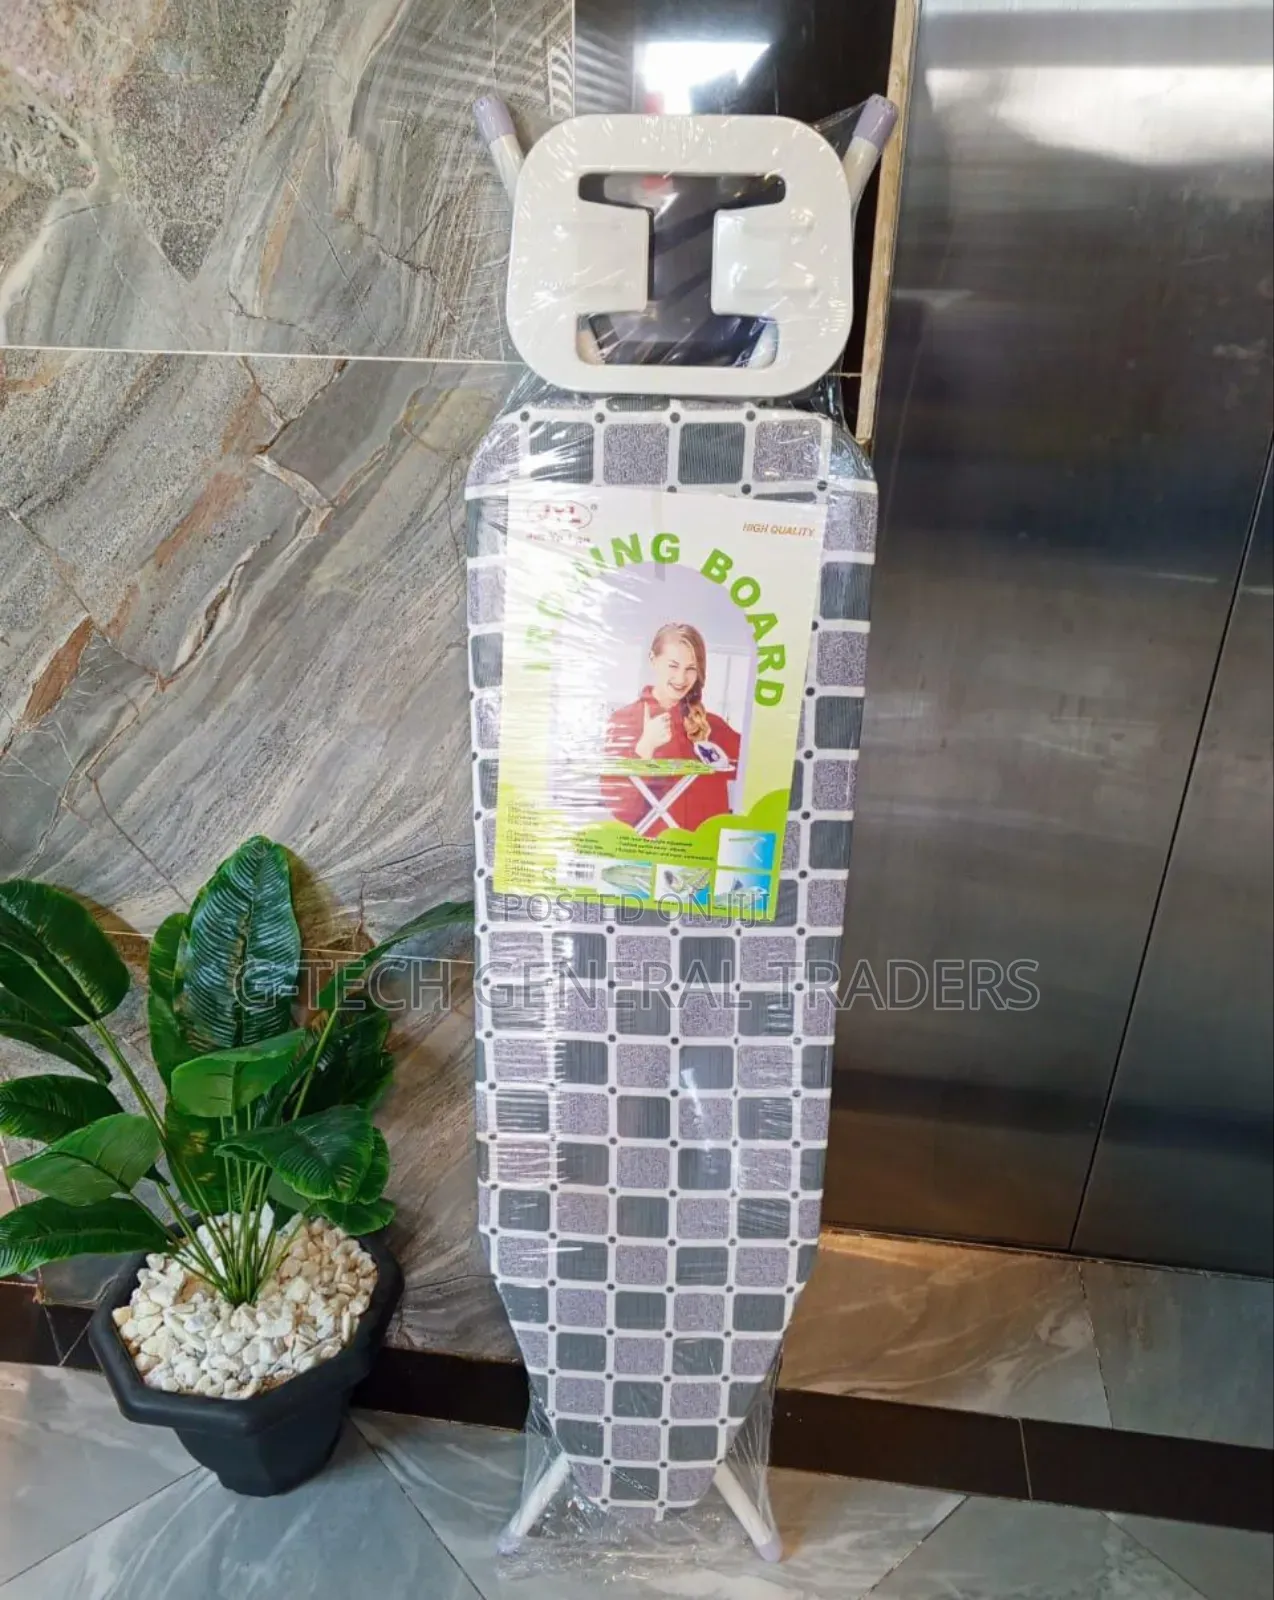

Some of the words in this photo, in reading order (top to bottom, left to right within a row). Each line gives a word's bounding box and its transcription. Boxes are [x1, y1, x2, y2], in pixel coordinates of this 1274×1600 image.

[742, 522, 769, 534] HIGH
[770, 524, 816, 537] QUALITY
[699, 548, 787, 707] BOARD
